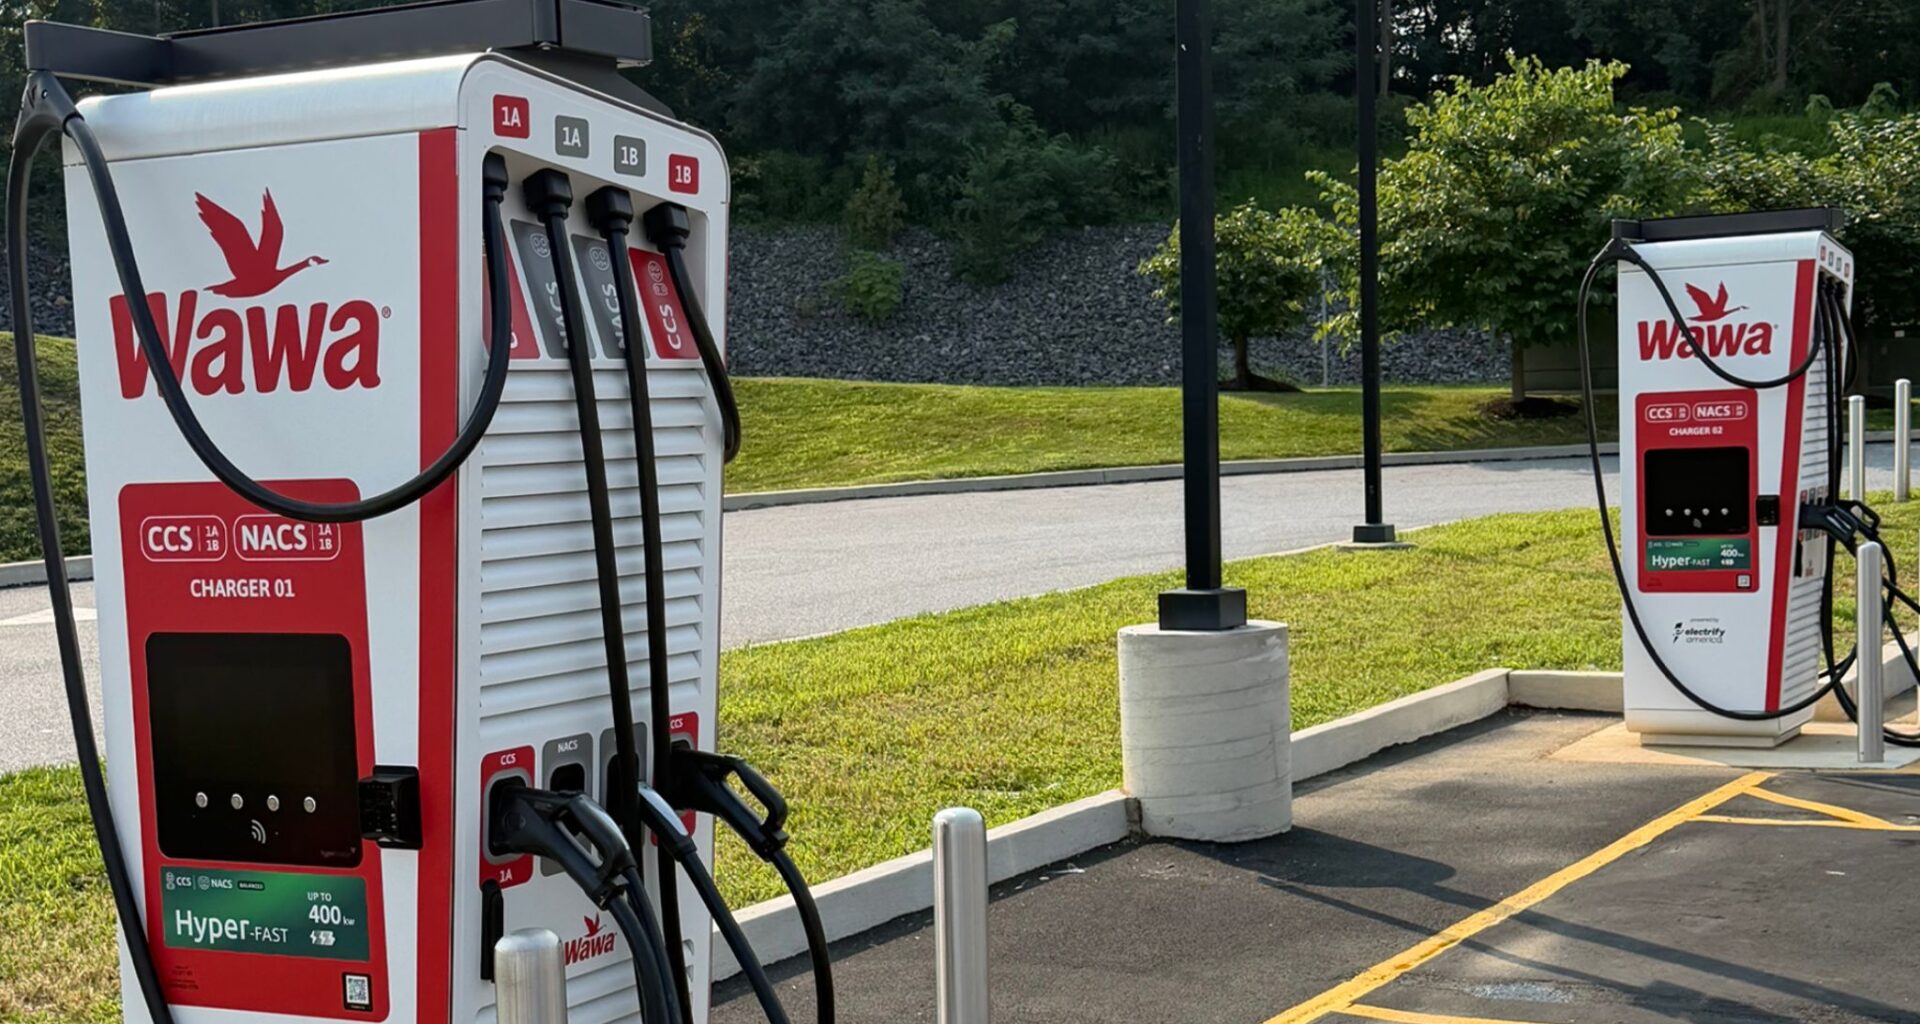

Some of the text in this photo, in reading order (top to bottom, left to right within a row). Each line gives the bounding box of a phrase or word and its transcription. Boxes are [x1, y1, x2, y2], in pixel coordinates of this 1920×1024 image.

[501, 106, 521, 127] 1A
[562, 126, 582, 148] 1A
[620, 146, 639, 166] 1B
[675, 165, 692, 185] 1B
[659, 303, 682, 350] CCS
[109, 289, 381, 400] Wawa
[1637, 319, 1773, 361] Wawa
[1648, 407, 1673, 419] CCS
[1696, 405, 1731, 418] NACS
[1669, 427, 1711, 436] CHARGER
[205, 525, 219, 538] 1A
[318, 523, 332, 536] 1A
[148, 525, 193, 552] CCS
[241, 523, 307, 551] NACS
[319, 538, 333, 550] 1B
[206, 539, 220, 552] 1B
[1720, 548, 1738, 558] 400
[190, 578, 295, 598] CHARGER 01
[669, 718, 684, 729] CCS
[557, 740, 578, 753] NACS
[500, 753, 516, 766] CCS
[499, 868, 513, 882] 1A
[176, 876, 233, 889] CCS NACS
[307, 891, 332, 902] UP TO
[308, 904, 341, 925] 400
[175, 908, 288, 944] Hyper-FAST
[564, 932, 616, 966] Wawa
